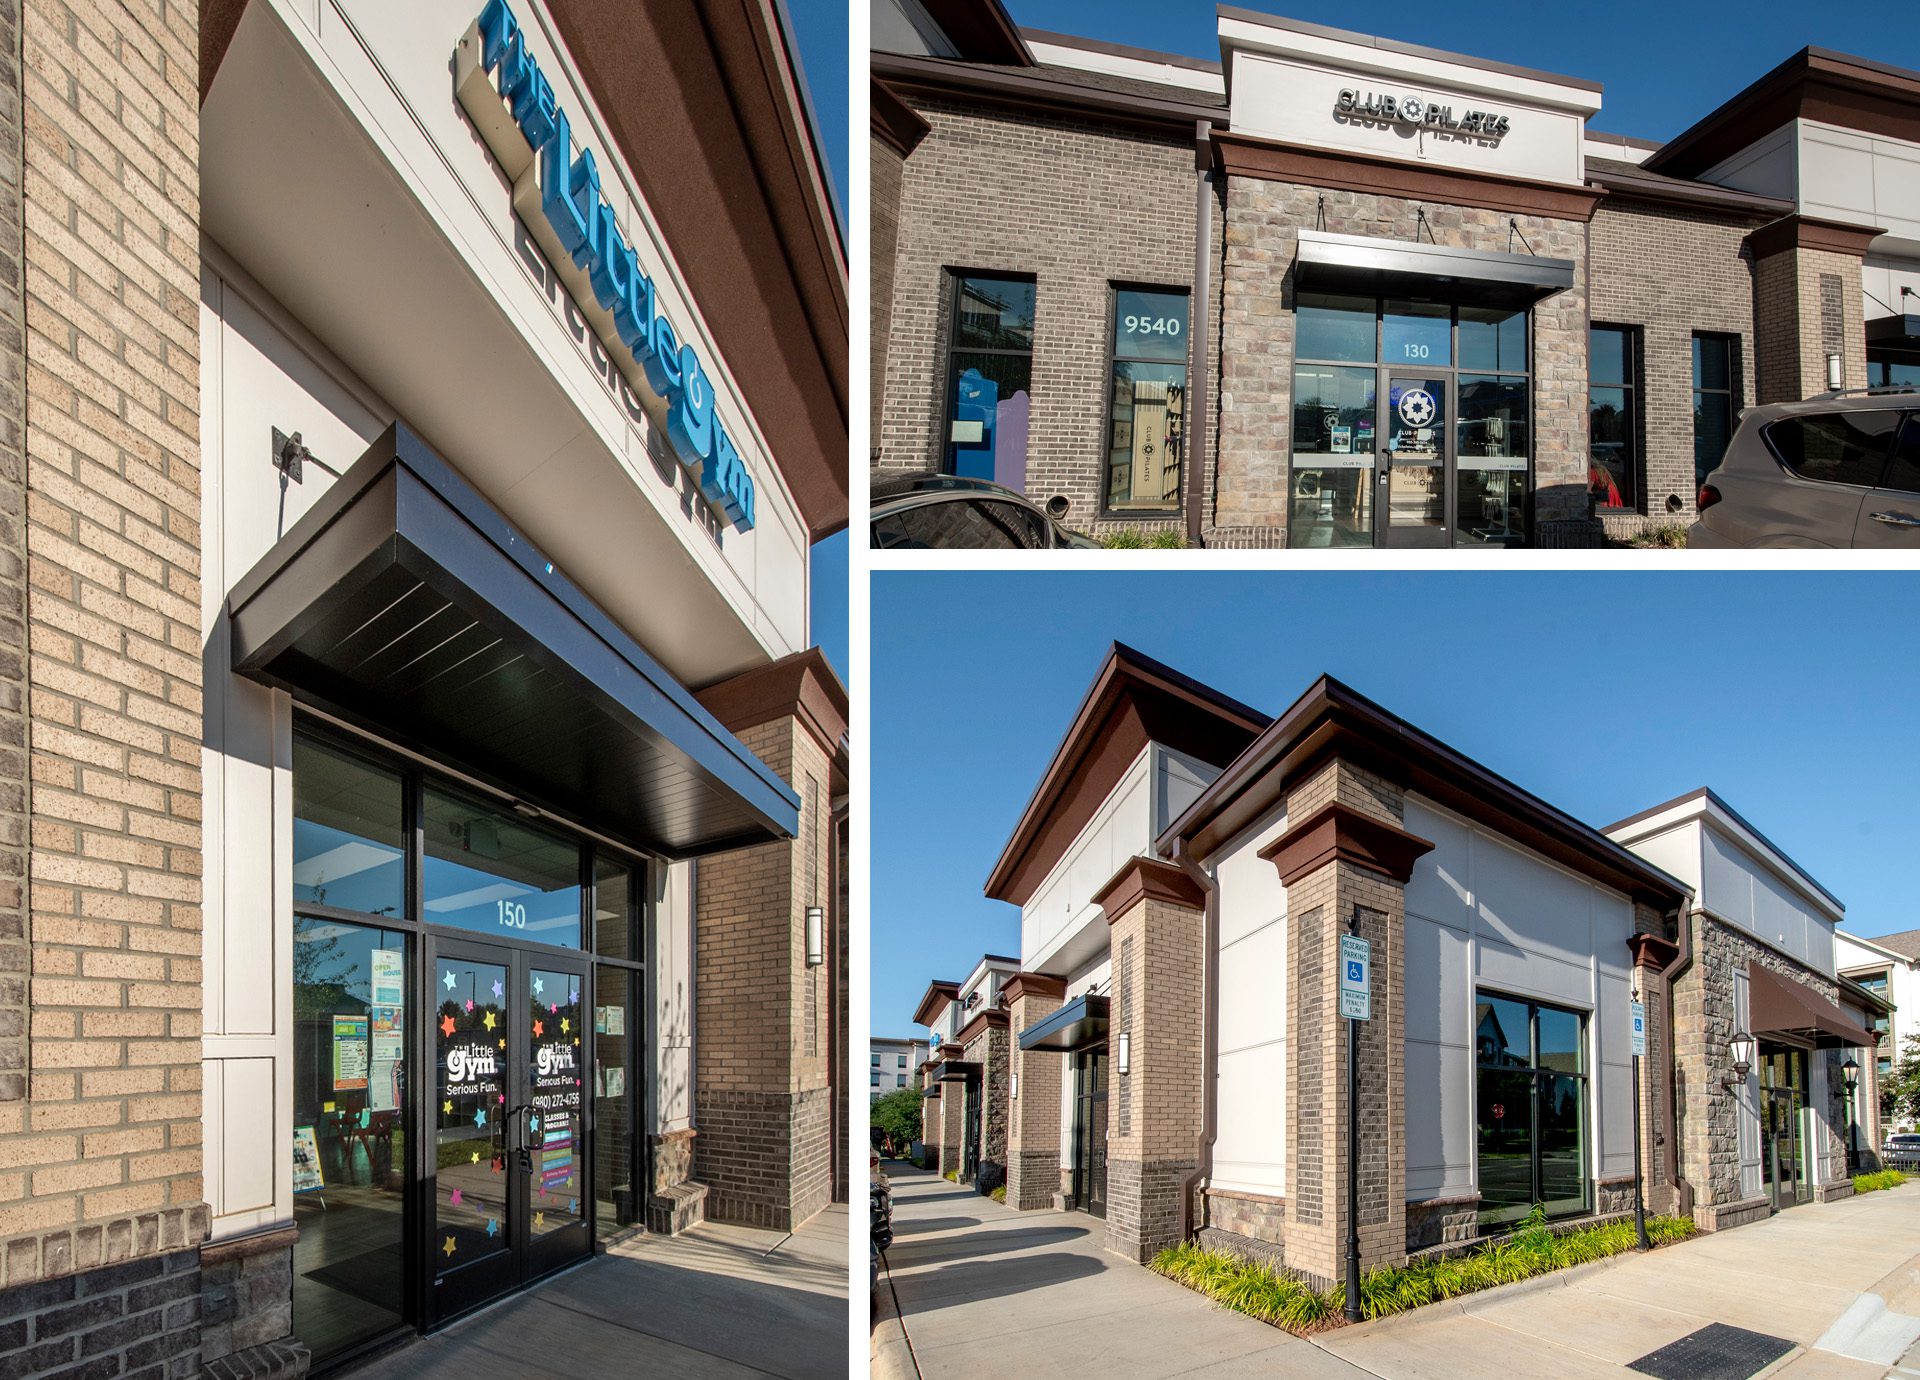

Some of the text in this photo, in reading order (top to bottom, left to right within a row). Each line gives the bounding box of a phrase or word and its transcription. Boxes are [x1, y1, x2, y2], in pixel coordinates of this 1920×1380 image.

[1337, 87, 1510, 137] CLUB PILATES
[546, 106, 682, 394] Little
[1124, 315, 1180, 336] 9540
[1404, 343, 1429, 359] 130
[497, 899, 526, 929] 150
[1342, 940, 1368, 953] RESERVED
[1343, 949, 1367, 962] PARKING
[466, 1042, 494, 1058] Little
[550, 1041, 572, 1055] Little
[446, 1082, 498, 1096] Serious Fun.
[536, 1077, 561, 1088] Serious
[544, 1112, 565, 1123] CLASSES
